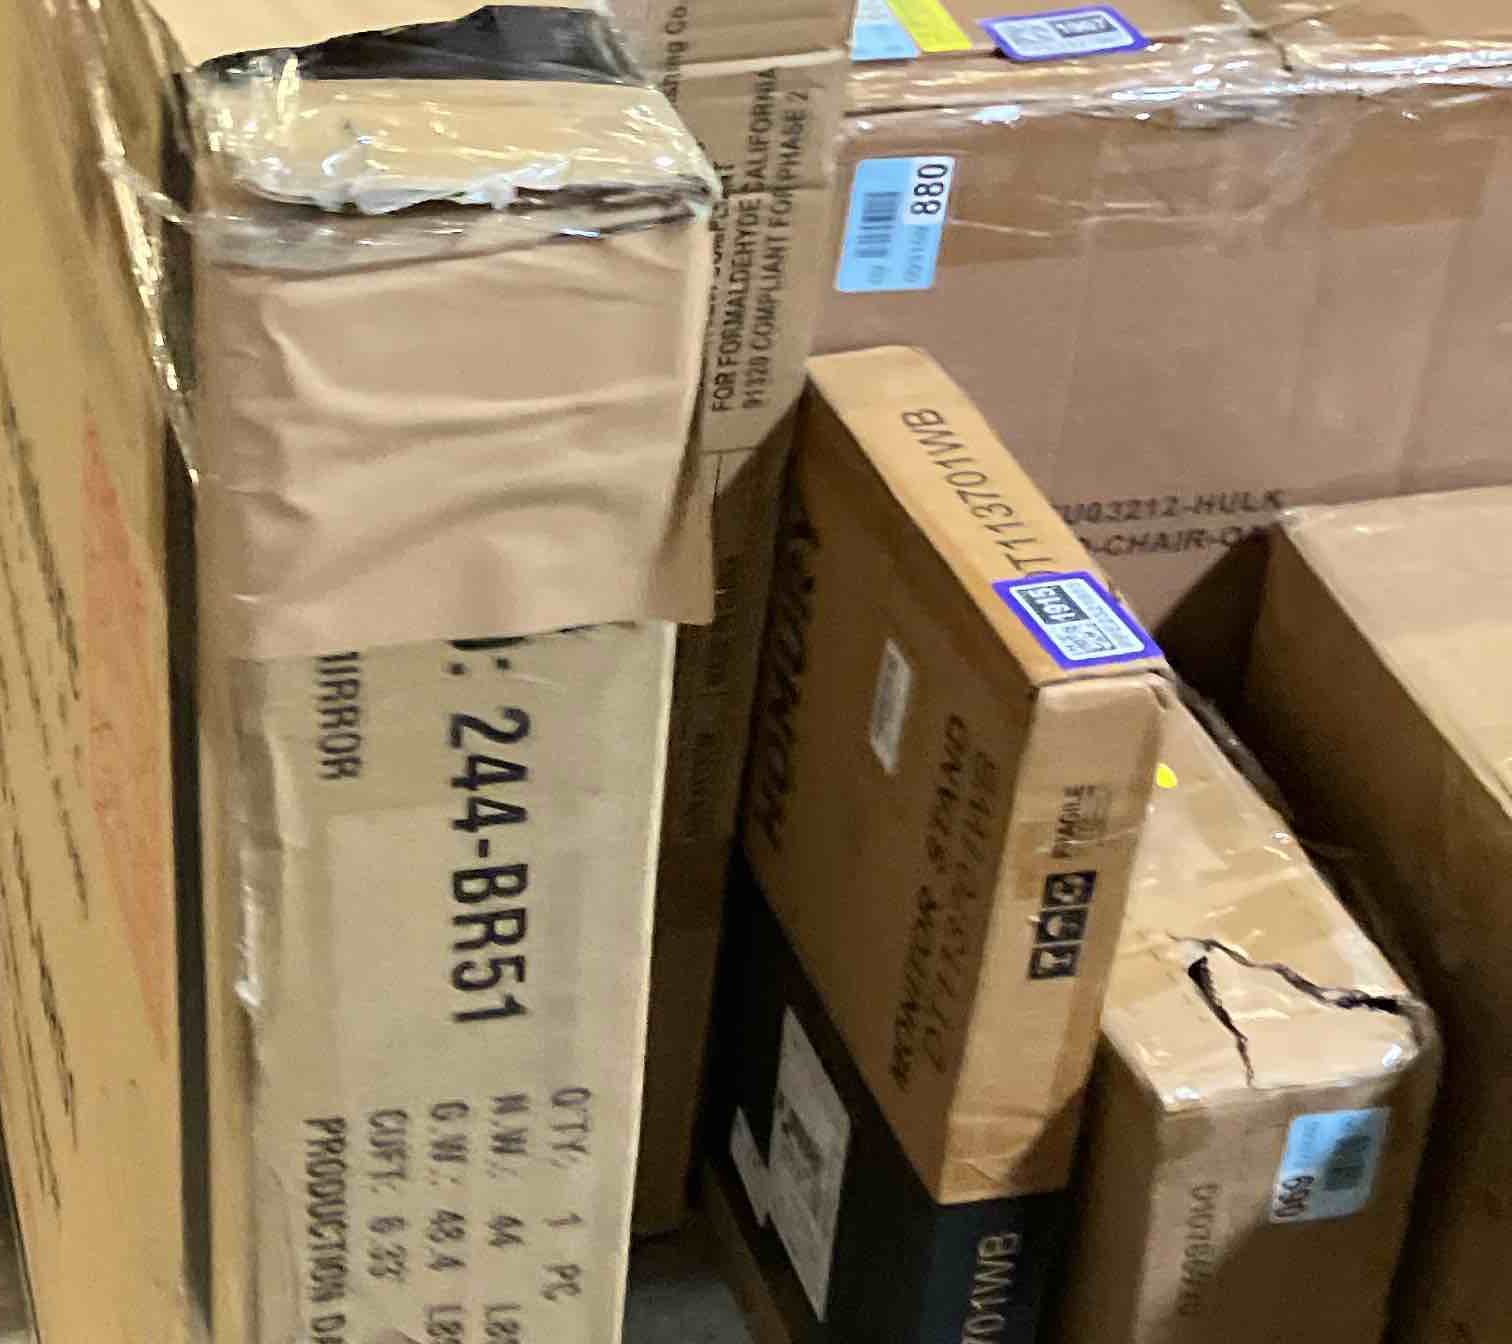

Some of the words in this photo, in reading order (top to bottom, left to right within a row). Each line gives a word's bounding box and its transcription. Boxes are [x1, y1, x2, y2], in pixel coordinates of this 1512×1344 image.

[741, 67, 777, 194] CALIFORNIA
[750, 236, 790, 352] COMPLIANT
[776, 109, 808, 181] PHASE
[909, 163, 948, 215] 880
[719, 199, 761, 366] FORMALDEHYDE
[711, 371, 737, 413] FOR
[901, 408, 1053, 575] T113701WB
[1025, 586, 1082, 625] 1915
[449, 706, 532, 1023] 244-BR51
[303, 1117, 348, 1304] PRODUCTION
[488, 1215, 524, 1248] 44
[541, 1212, 583, 1227] 1
[541, 1263, 581, 1302] PC
